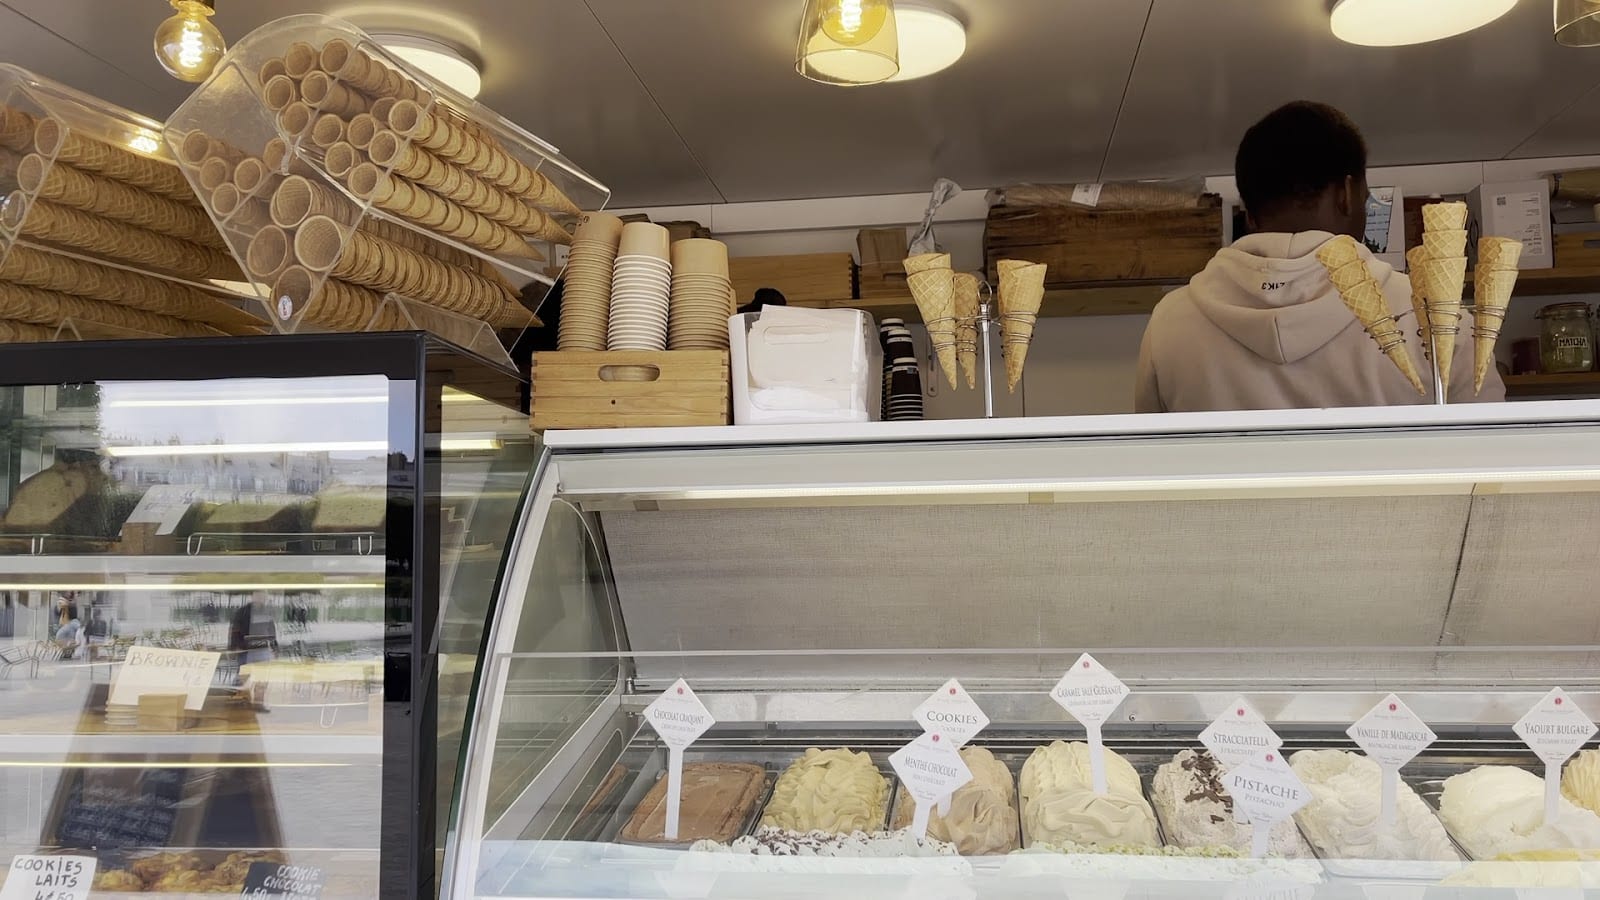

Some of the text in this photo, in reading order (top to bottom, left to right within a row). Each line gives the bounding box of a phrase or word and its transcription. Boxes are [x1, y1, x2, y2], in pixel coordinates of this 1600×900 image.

[129, 651, 210, 669] BROWNIE
[926, 710, 978, 725] COOKIES
[1356, 728, 1380, 739] VANILLE
[1524, 723, 1589, 736] YAOURT BULGARE
[1213, 732, 1270, 747] STRACCIATELLA
[903, 755, 958, 778] MENTHE CHOCOLAT
[1233, 775, 1299, 801] PISTACHE
[14, 856, 83, 875] COOKIES
[276, 864, 321, 881] COOKIE
[35, 873, 78, 888] LAITS
[263, 875, 322, 895] CHOCOLAT
